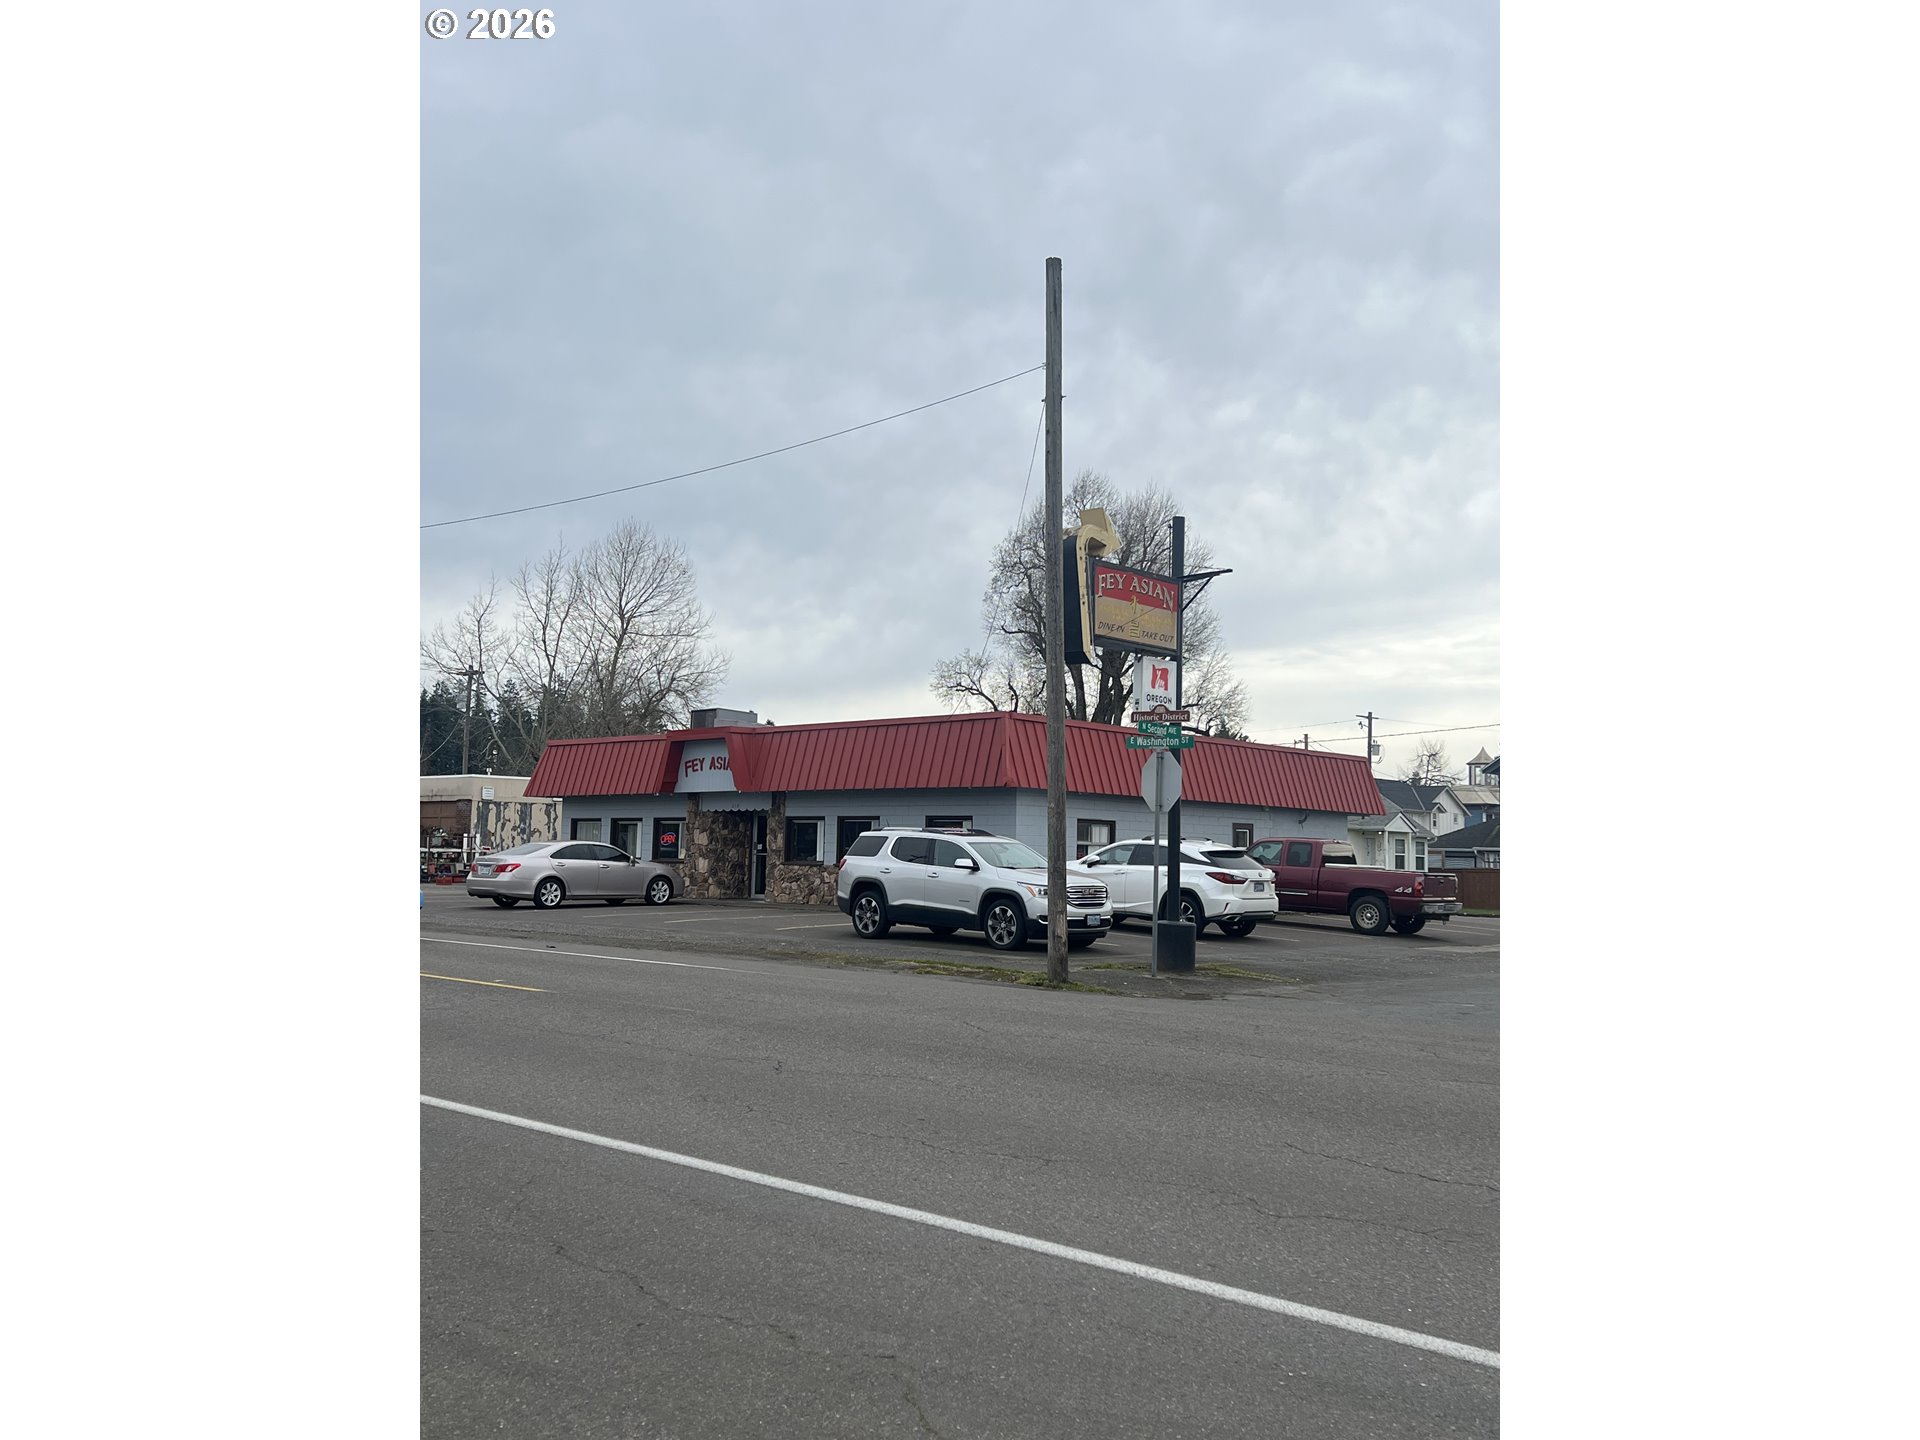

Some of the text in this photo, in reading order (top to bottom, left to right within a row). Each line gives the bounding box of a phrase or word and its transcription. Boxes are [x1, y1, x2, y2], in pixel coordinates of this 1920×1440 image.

[1098, 573, 1175, 613] FEY ASIAN
[1142, 630, 1174, 643] TAKE OUT
[1146, 693, 1172, 704] OREGON
[1133, 713, 1188, 721] Historic District
[1147, 723, 1167, 735] Second
[1137, 736, 1179, 747] Washington
[684, 757, 705, 778] FEY
